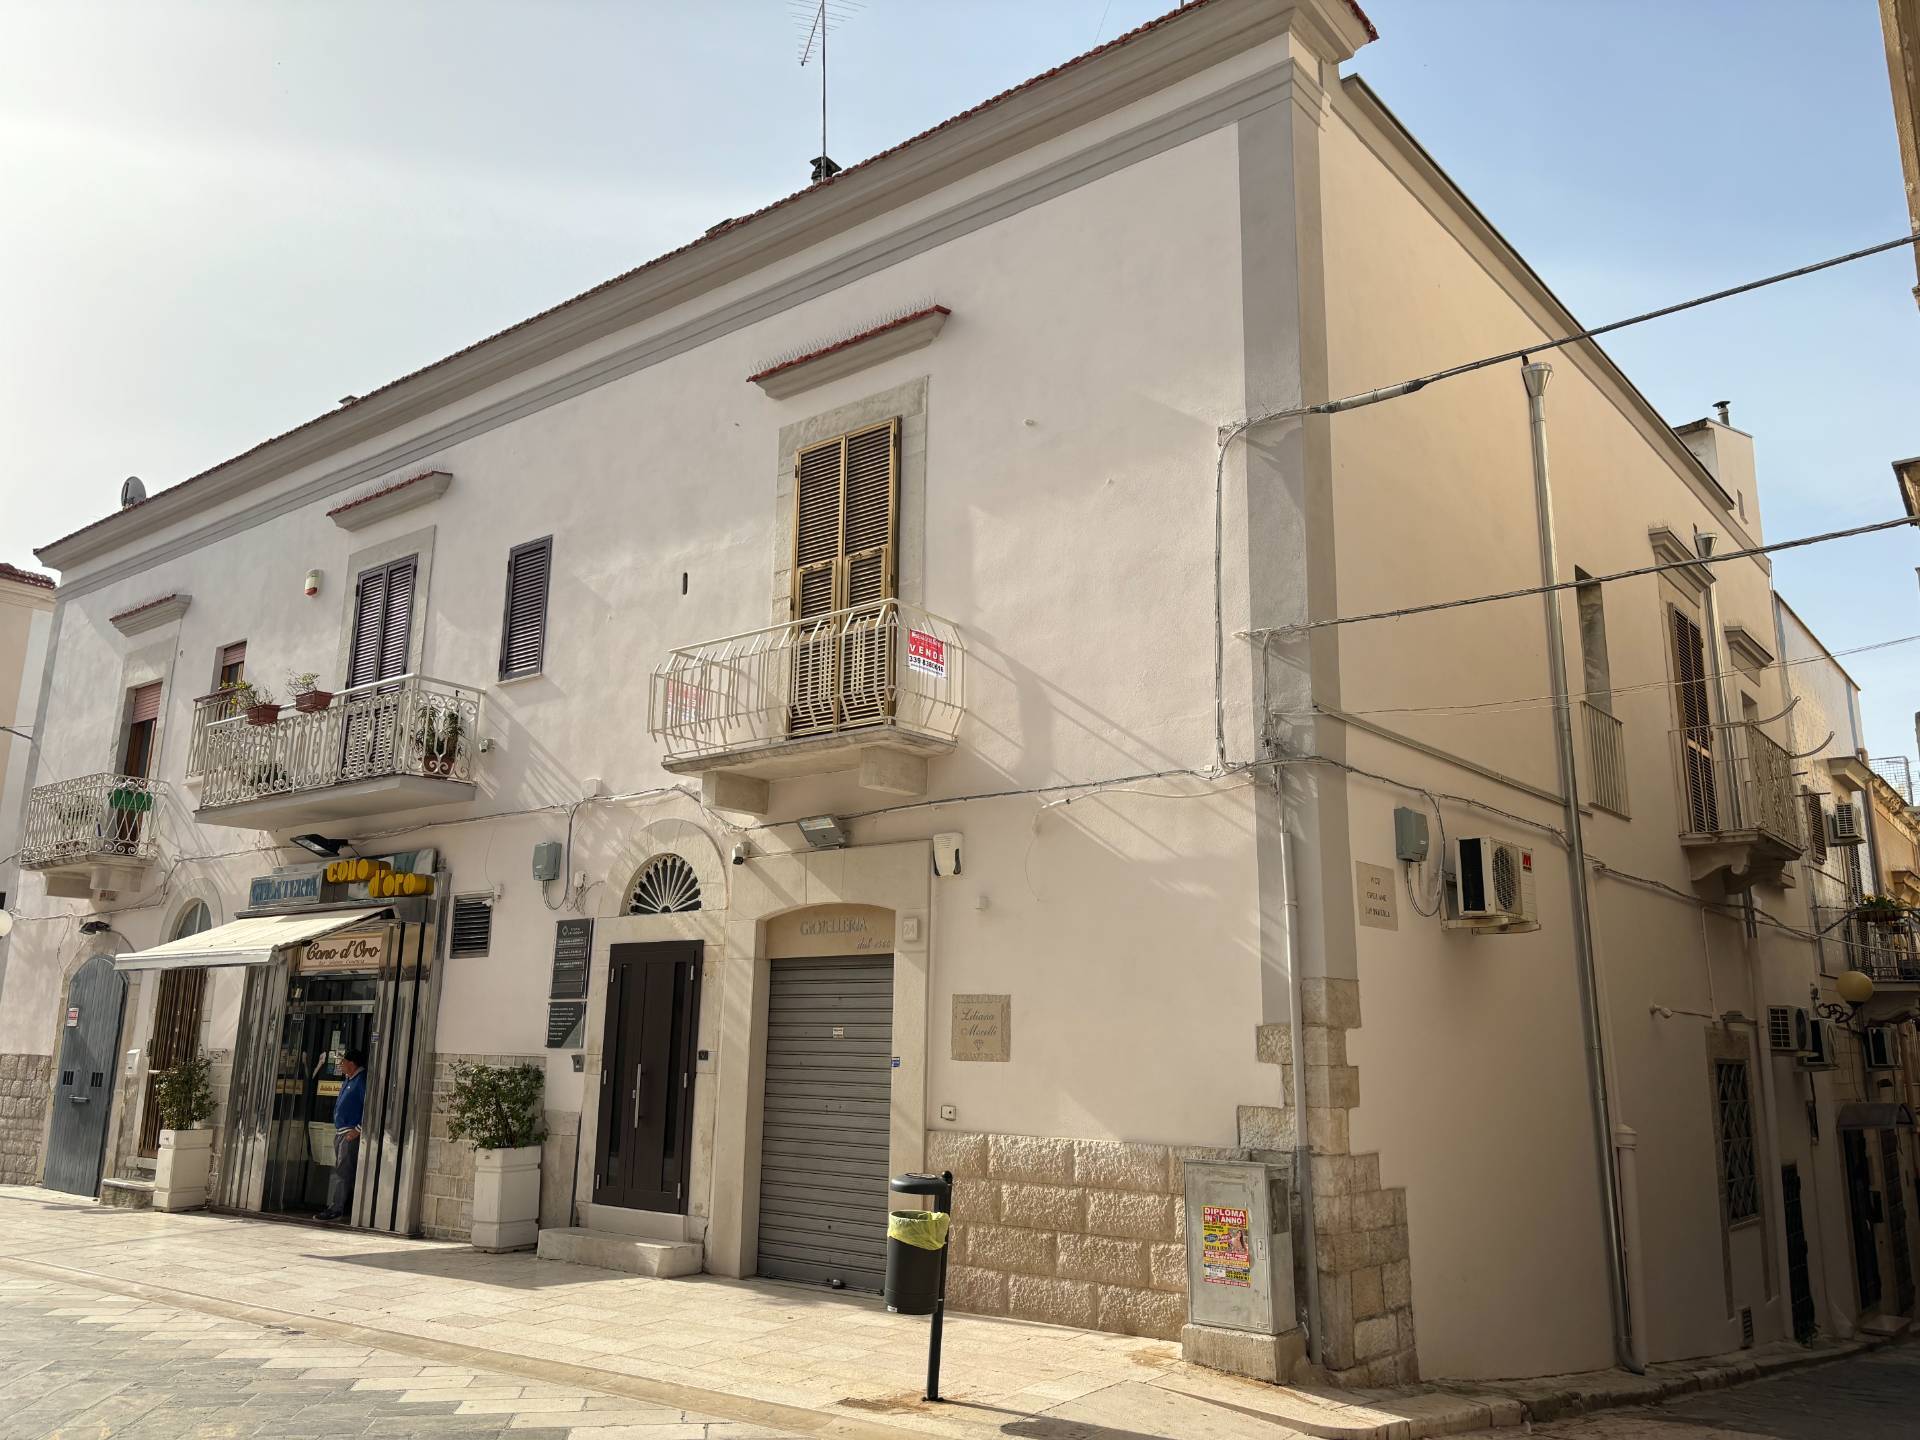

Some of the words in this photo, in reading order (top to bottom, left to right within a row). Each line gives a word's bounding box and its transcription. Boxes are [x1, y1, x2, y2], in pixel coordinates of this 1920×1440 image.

[910, 645, 944, 662] VENDE
[369, 869, 416, 897] d'oro
[306, 942, 339, 960] Cono
[339, 940, 381, 959] d'Oro
[1204, 1207, 1245, 1218] DIPLOMA
